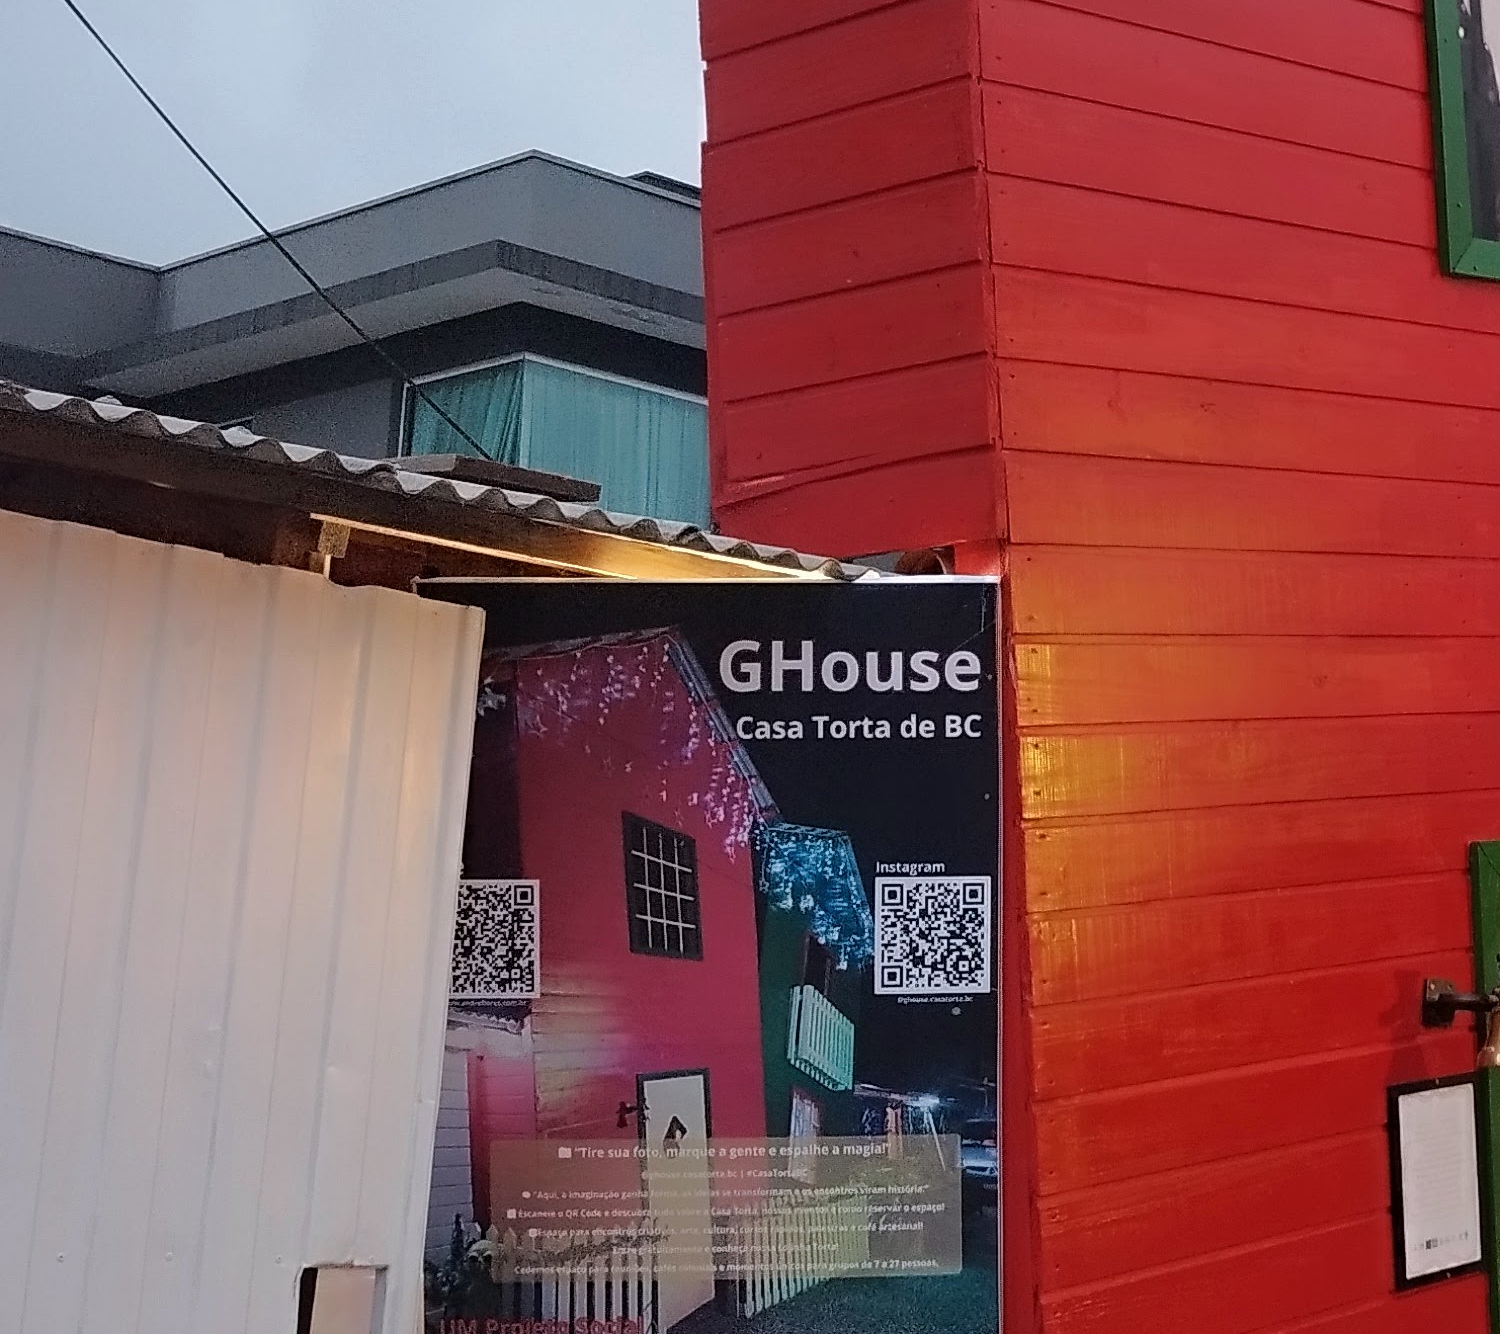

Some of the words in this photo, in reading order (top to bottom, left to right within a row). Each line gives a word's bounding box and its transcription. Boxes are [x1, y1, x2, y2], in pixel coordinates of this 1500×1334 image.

[719, 640, 981, 692] GHouse
[737, 717, 804, 739] Casa
[811, 716, 891, 739] Torta
[900, 714, 935, 738] de
[945, 715, 982, 738] BC
[876, 861, 945, 876] Instagram
[608, 1149, 630, 1158] sua
[633, 1147, 662, 1159] foto,
[666, 1148, 715, 1160] marque
[719, 1148, 727, 1156] a
[729, 1145, 765, 1159] gente
[769, 1147, 777, 1155] e
[780, 1143, 829, 1159] espalhe
[832, 1146, 839, 1155] a
[569, 1189, 619, 1200] imaginação
[733, 1186, 792, 1197] transformam
